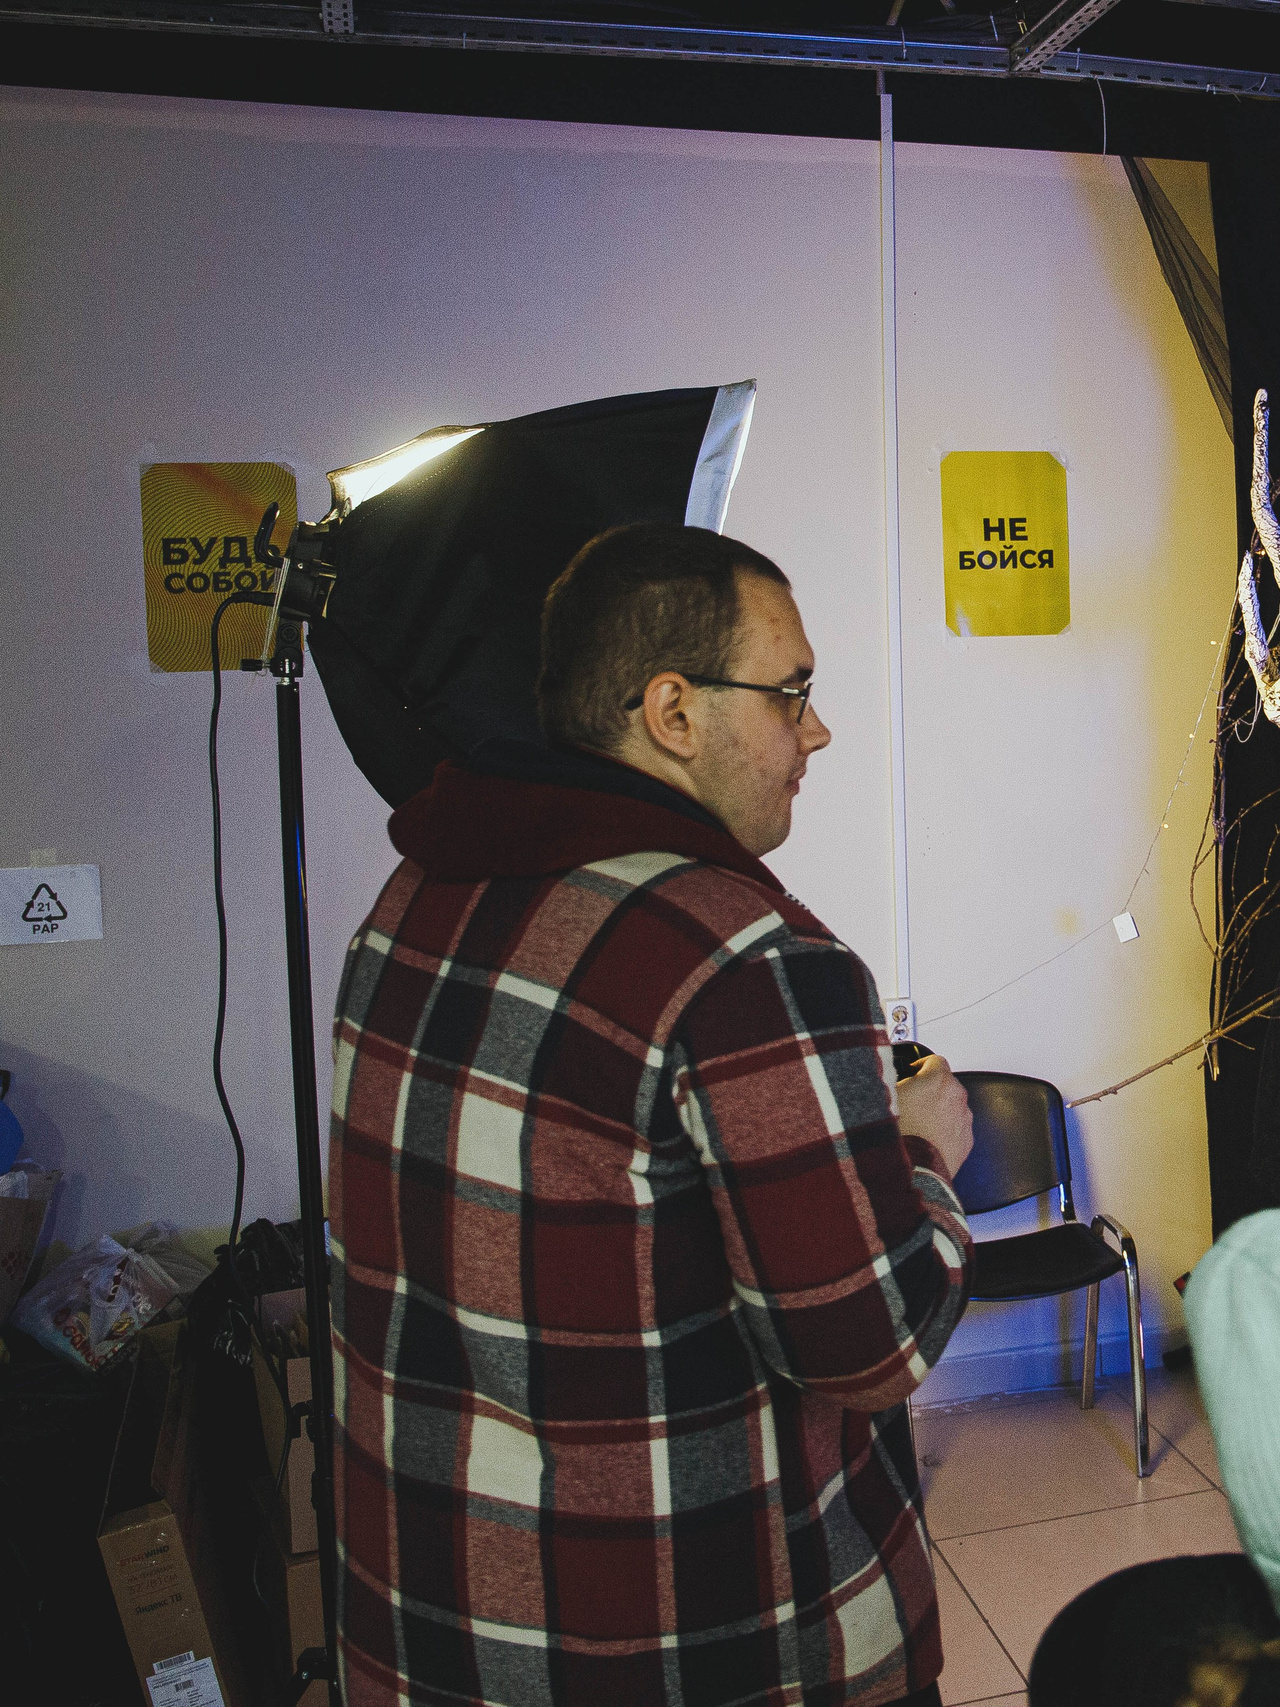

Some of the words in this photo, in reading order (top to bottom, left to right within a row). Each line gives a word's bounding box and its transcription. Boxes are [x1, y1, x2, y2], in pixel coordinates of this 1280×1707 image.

[983, 517, 1028, 541] НЕ
[162, 536, 279, 569] БУД
[959, 545, 1054, 570] БОЙСЯ
[37, 902, 51, 912] 21
[32, 923, 59, 934] PAP
[119, 1544, 170, 1567] STARWIND
[169, 1593, 183, 1604] ТВ
